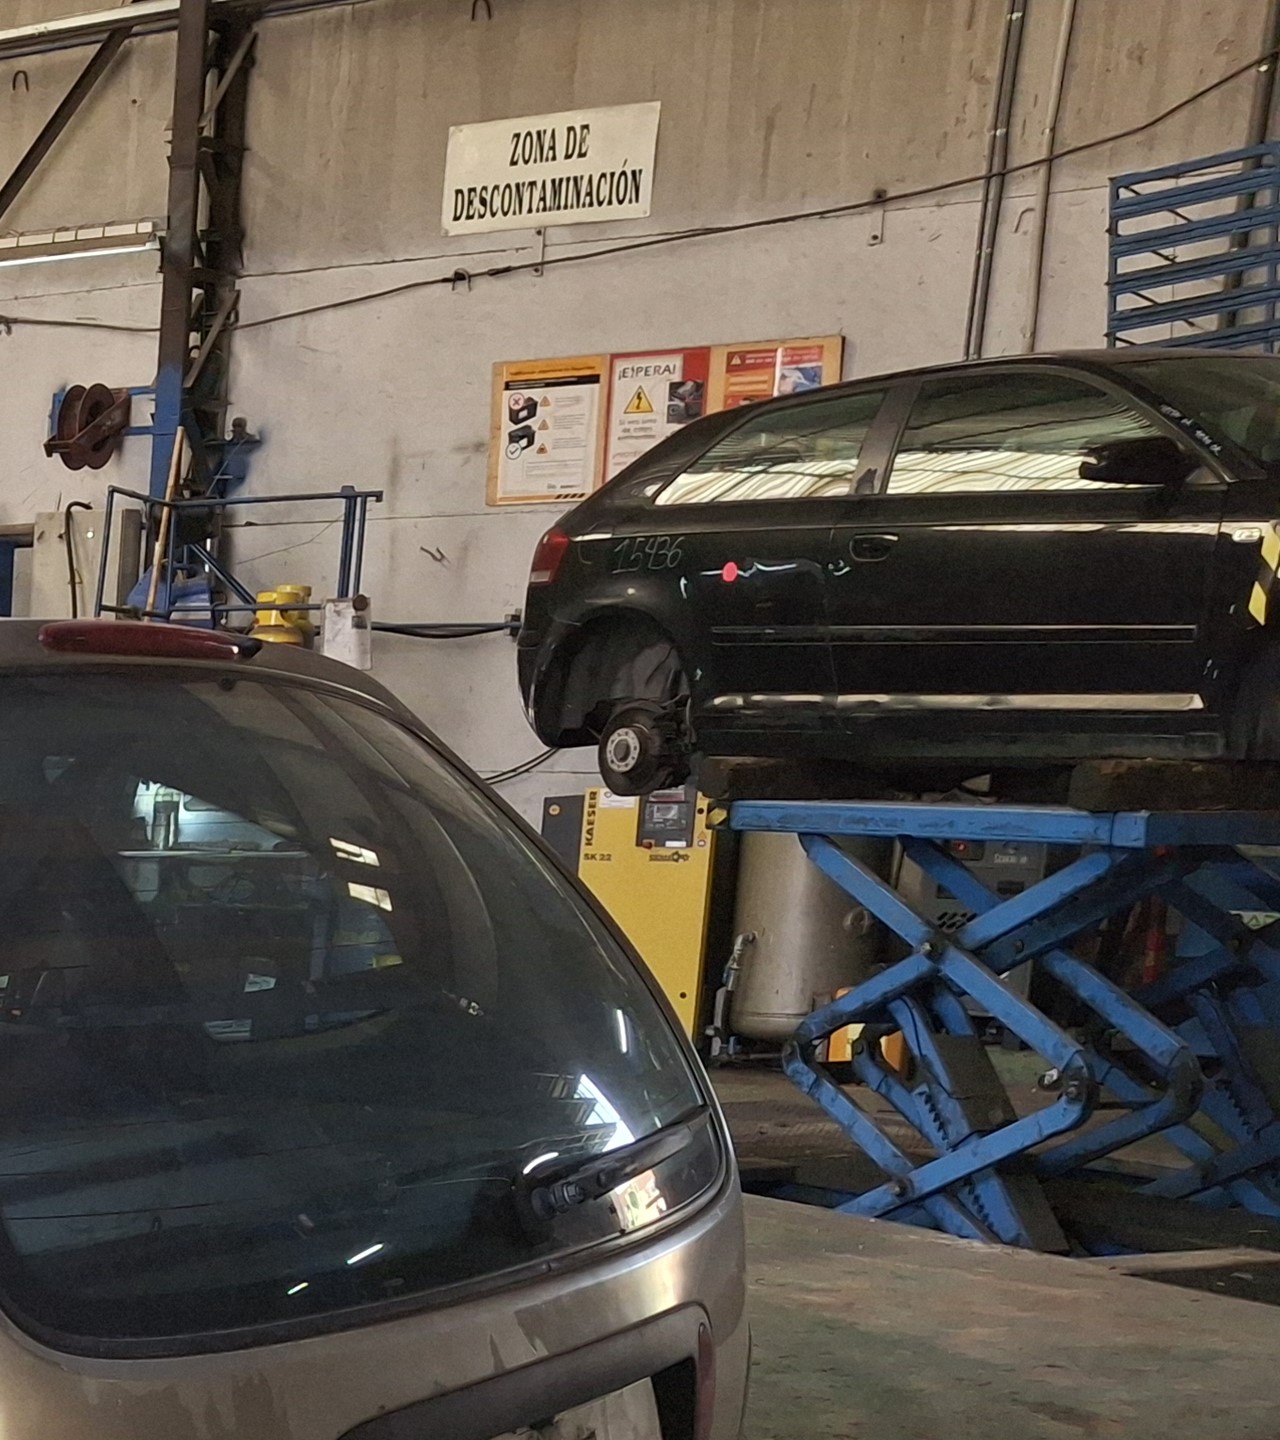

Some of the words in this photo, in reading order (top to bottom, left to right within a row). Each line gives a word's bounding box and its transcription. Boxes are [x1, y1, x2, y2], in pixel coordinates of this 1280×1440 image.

[509, 128, 557, 167] ZONA
[564, 124, 591, 160] DE
[452, 158, 643, 222] DESCONTAMINACIÓN
[585, 791, 598, 847] KAESER
[582, 852, 598, 862] SK
[598, 852, 613, 862] 22
